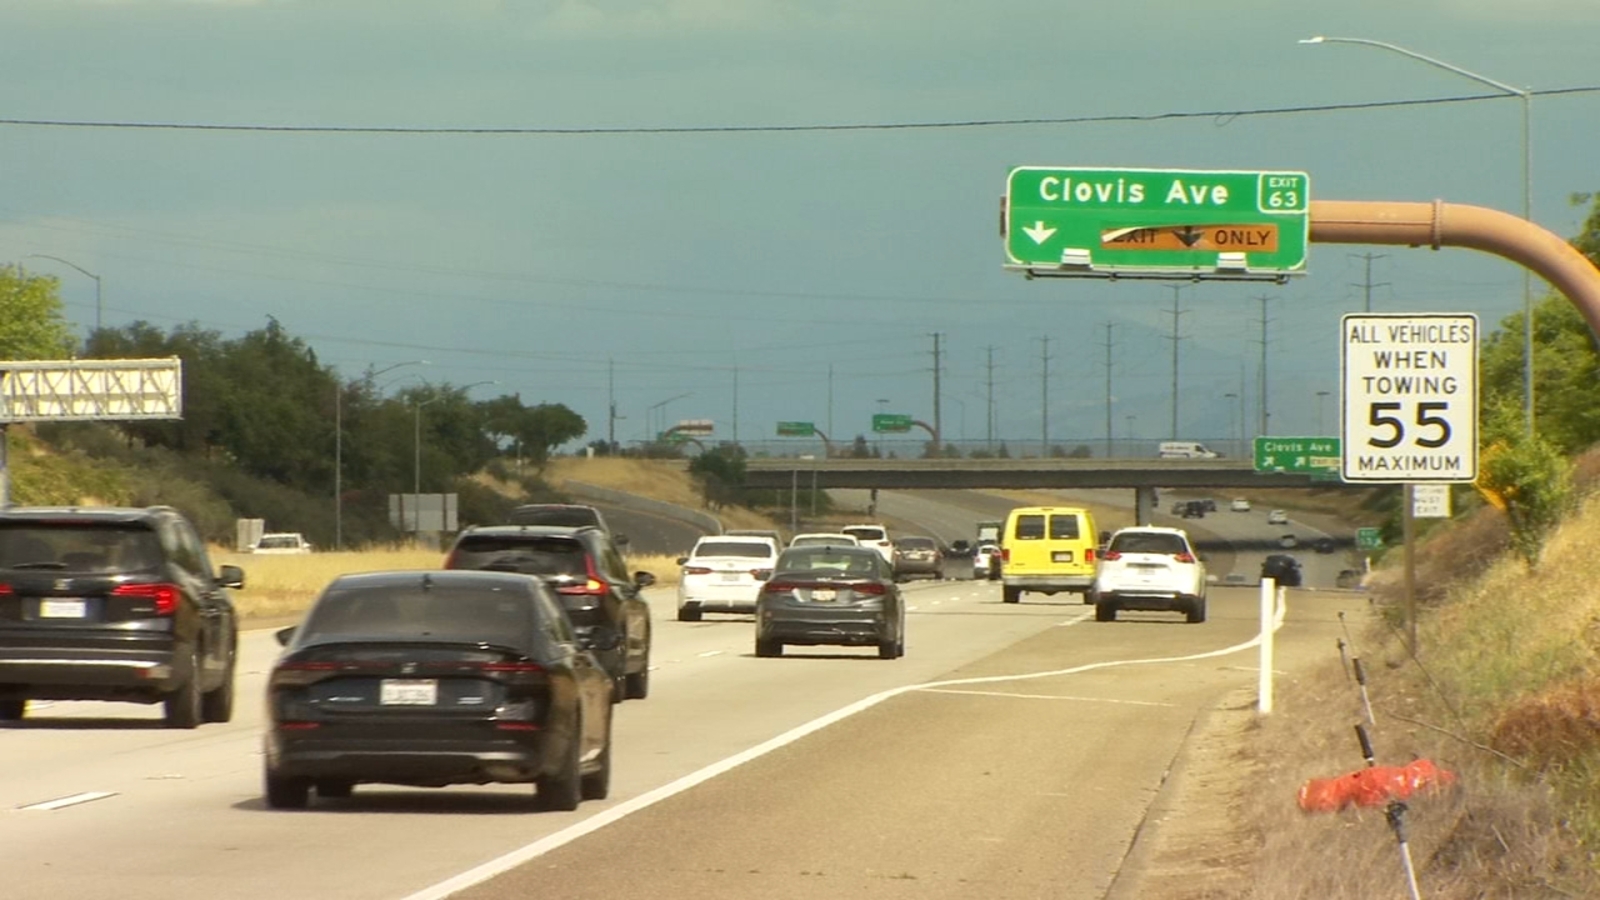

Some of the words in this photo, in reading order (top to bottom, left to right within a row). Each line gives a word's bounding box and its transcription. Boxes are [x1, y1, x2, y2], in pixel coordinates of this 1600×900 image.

[1039, 177, 1145, 204] Clovis
[1165, 179, 1228, 205] Ave
[1269, 177, 1299, 188] EXIT
[1269, 192, 1298, 207] 63
[1215, 230, 1271, 246] ONLY
[1350, 325, 1381, 343] ALL
[1389, 325, 1471, 343] VEHICLES
[1374, 351, 1447, 369] WHEN
[1363, 376, 1457, 394] TOWING
[1367, 402, 1452, 448] 55
[1264, 442, 1303, 452] Clovis
[1309, 442, 1332, 452] Ave
[1359, 456, 1460, 471] MAXIMUM
